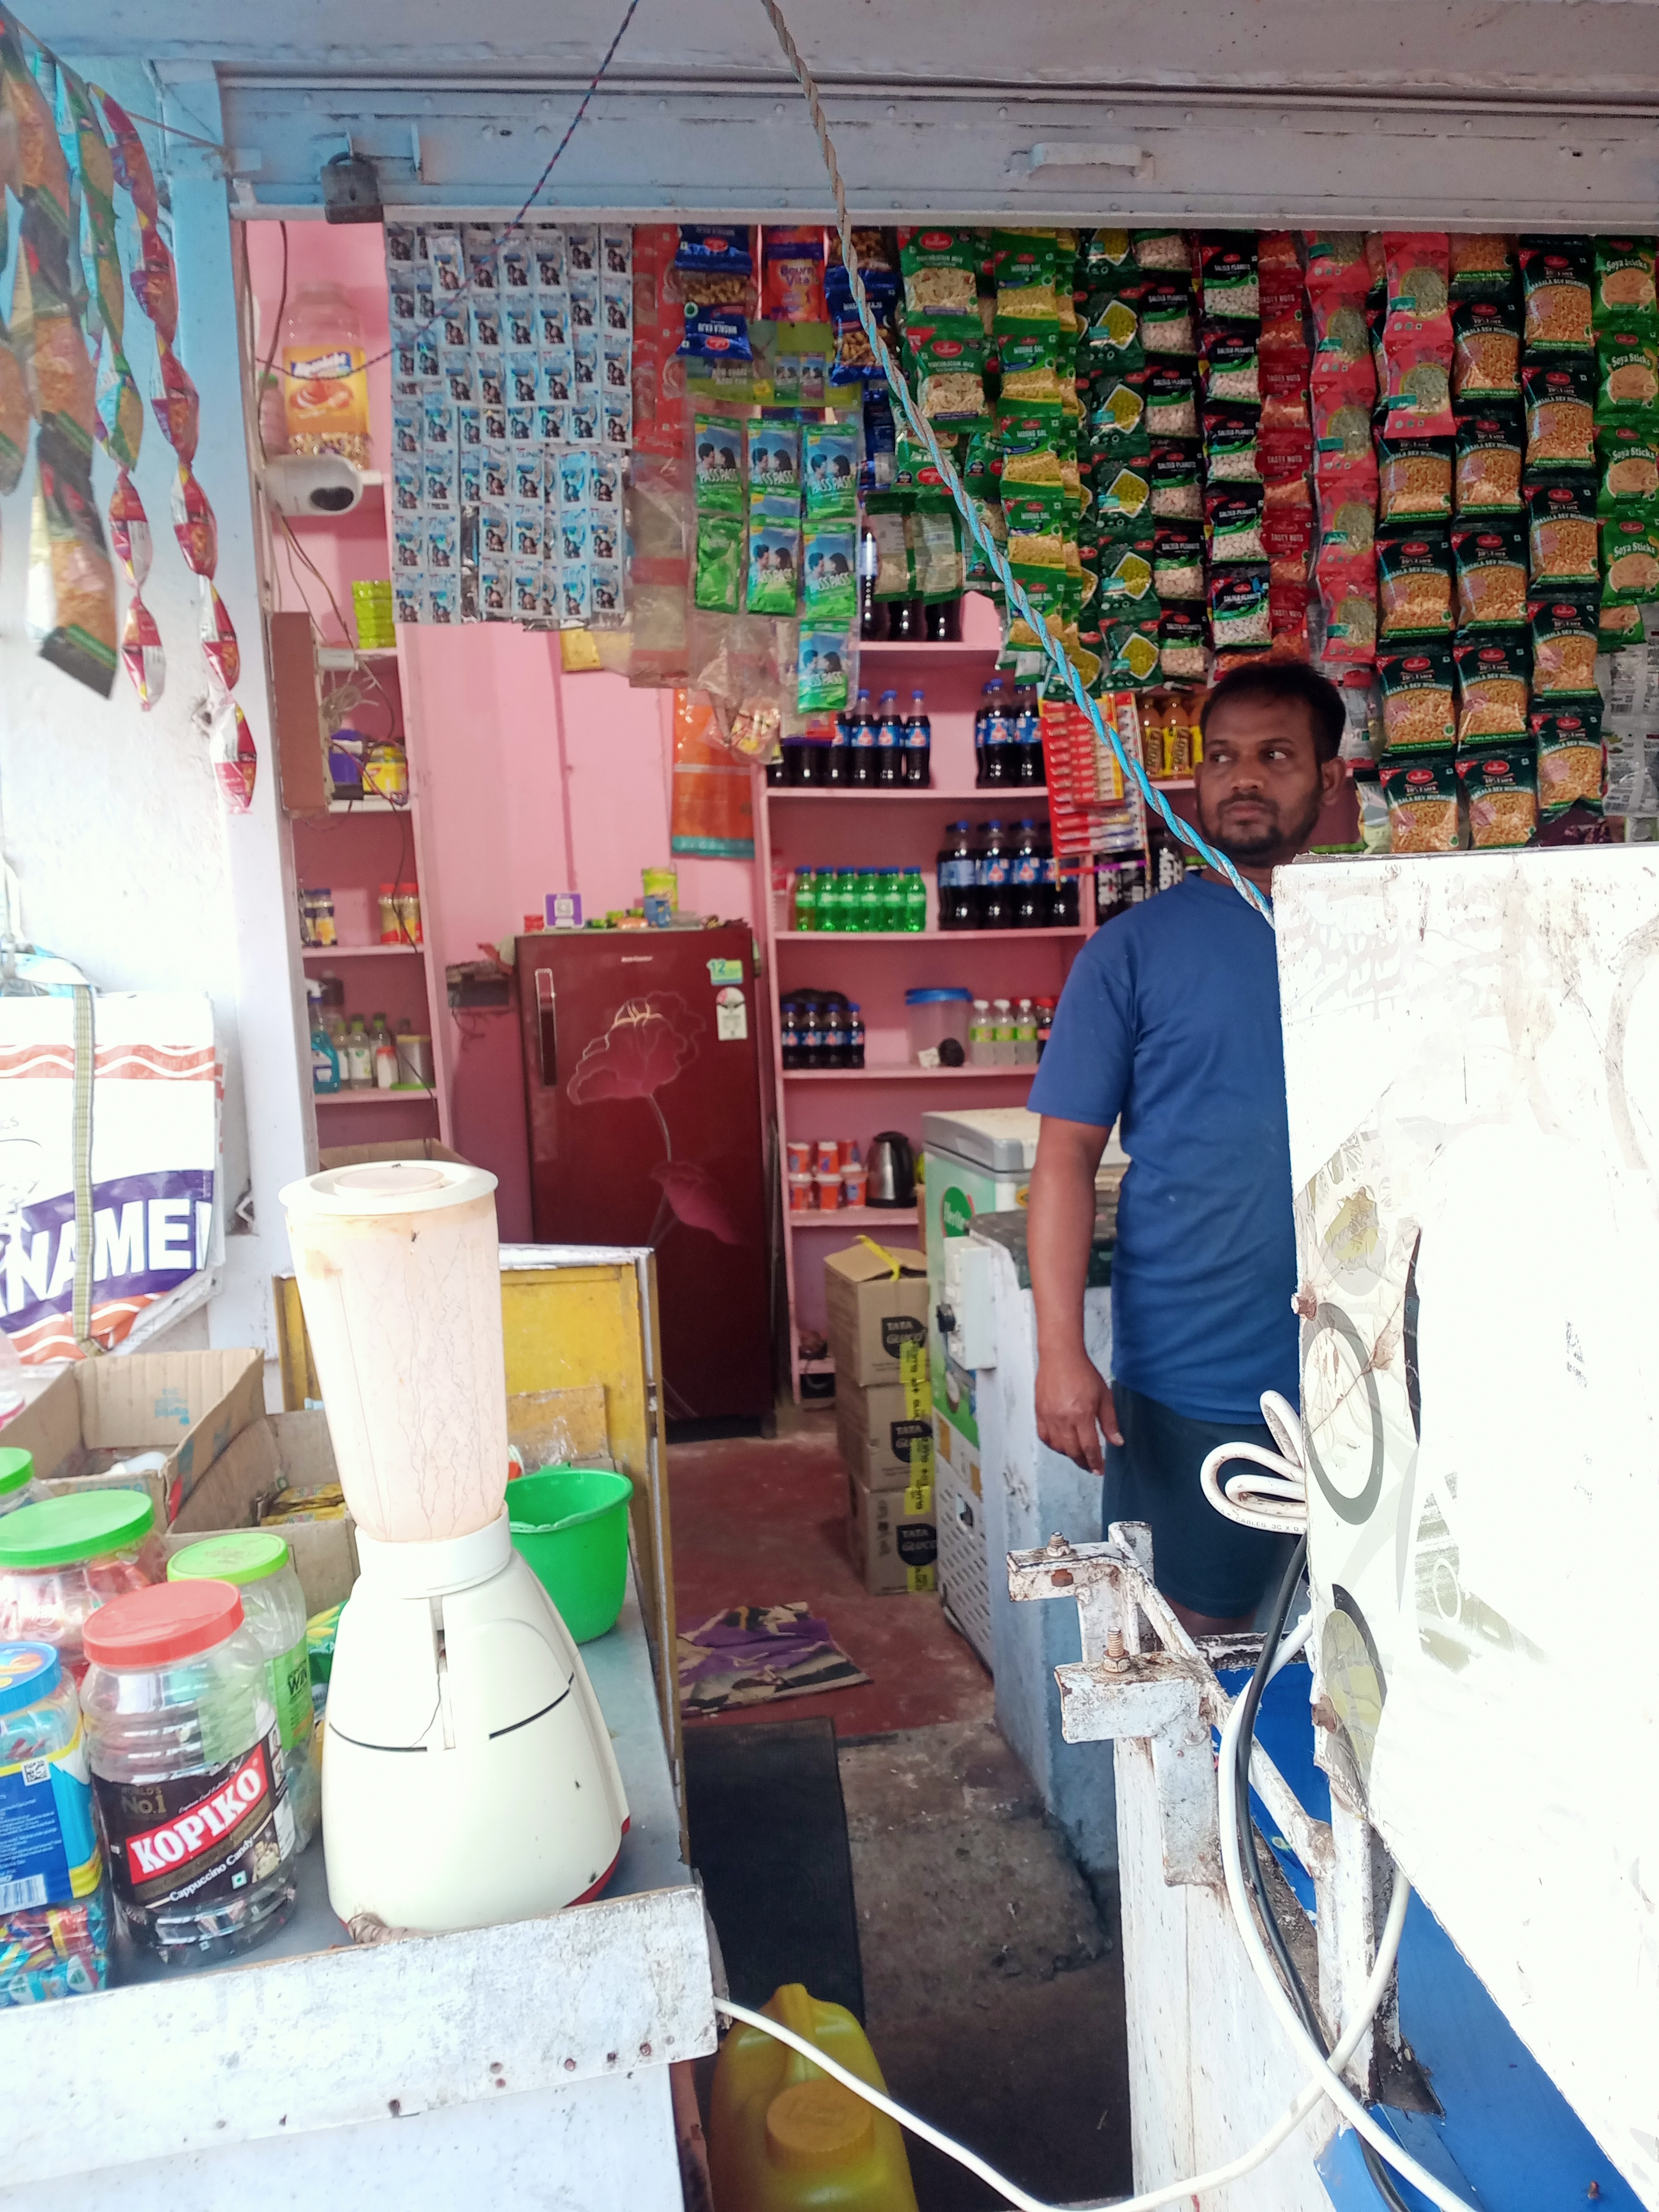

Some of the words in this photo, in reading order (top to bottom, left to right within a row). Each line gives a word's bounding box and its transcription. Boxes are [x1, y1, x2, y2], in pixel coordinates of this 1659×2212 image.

[886, 1321, 914, 1331] TATA
[895, 1425, 923, 1435] TATA
[1235, 1516, 1266, 1528] CABLES
[902, 1528, 929, 1539] TATA
[130, 1768, 261, 1874] KOPIKO
[168, 1862, 227, 1902] Cappuccino
[225, 1837, 255, 1866] Candy
